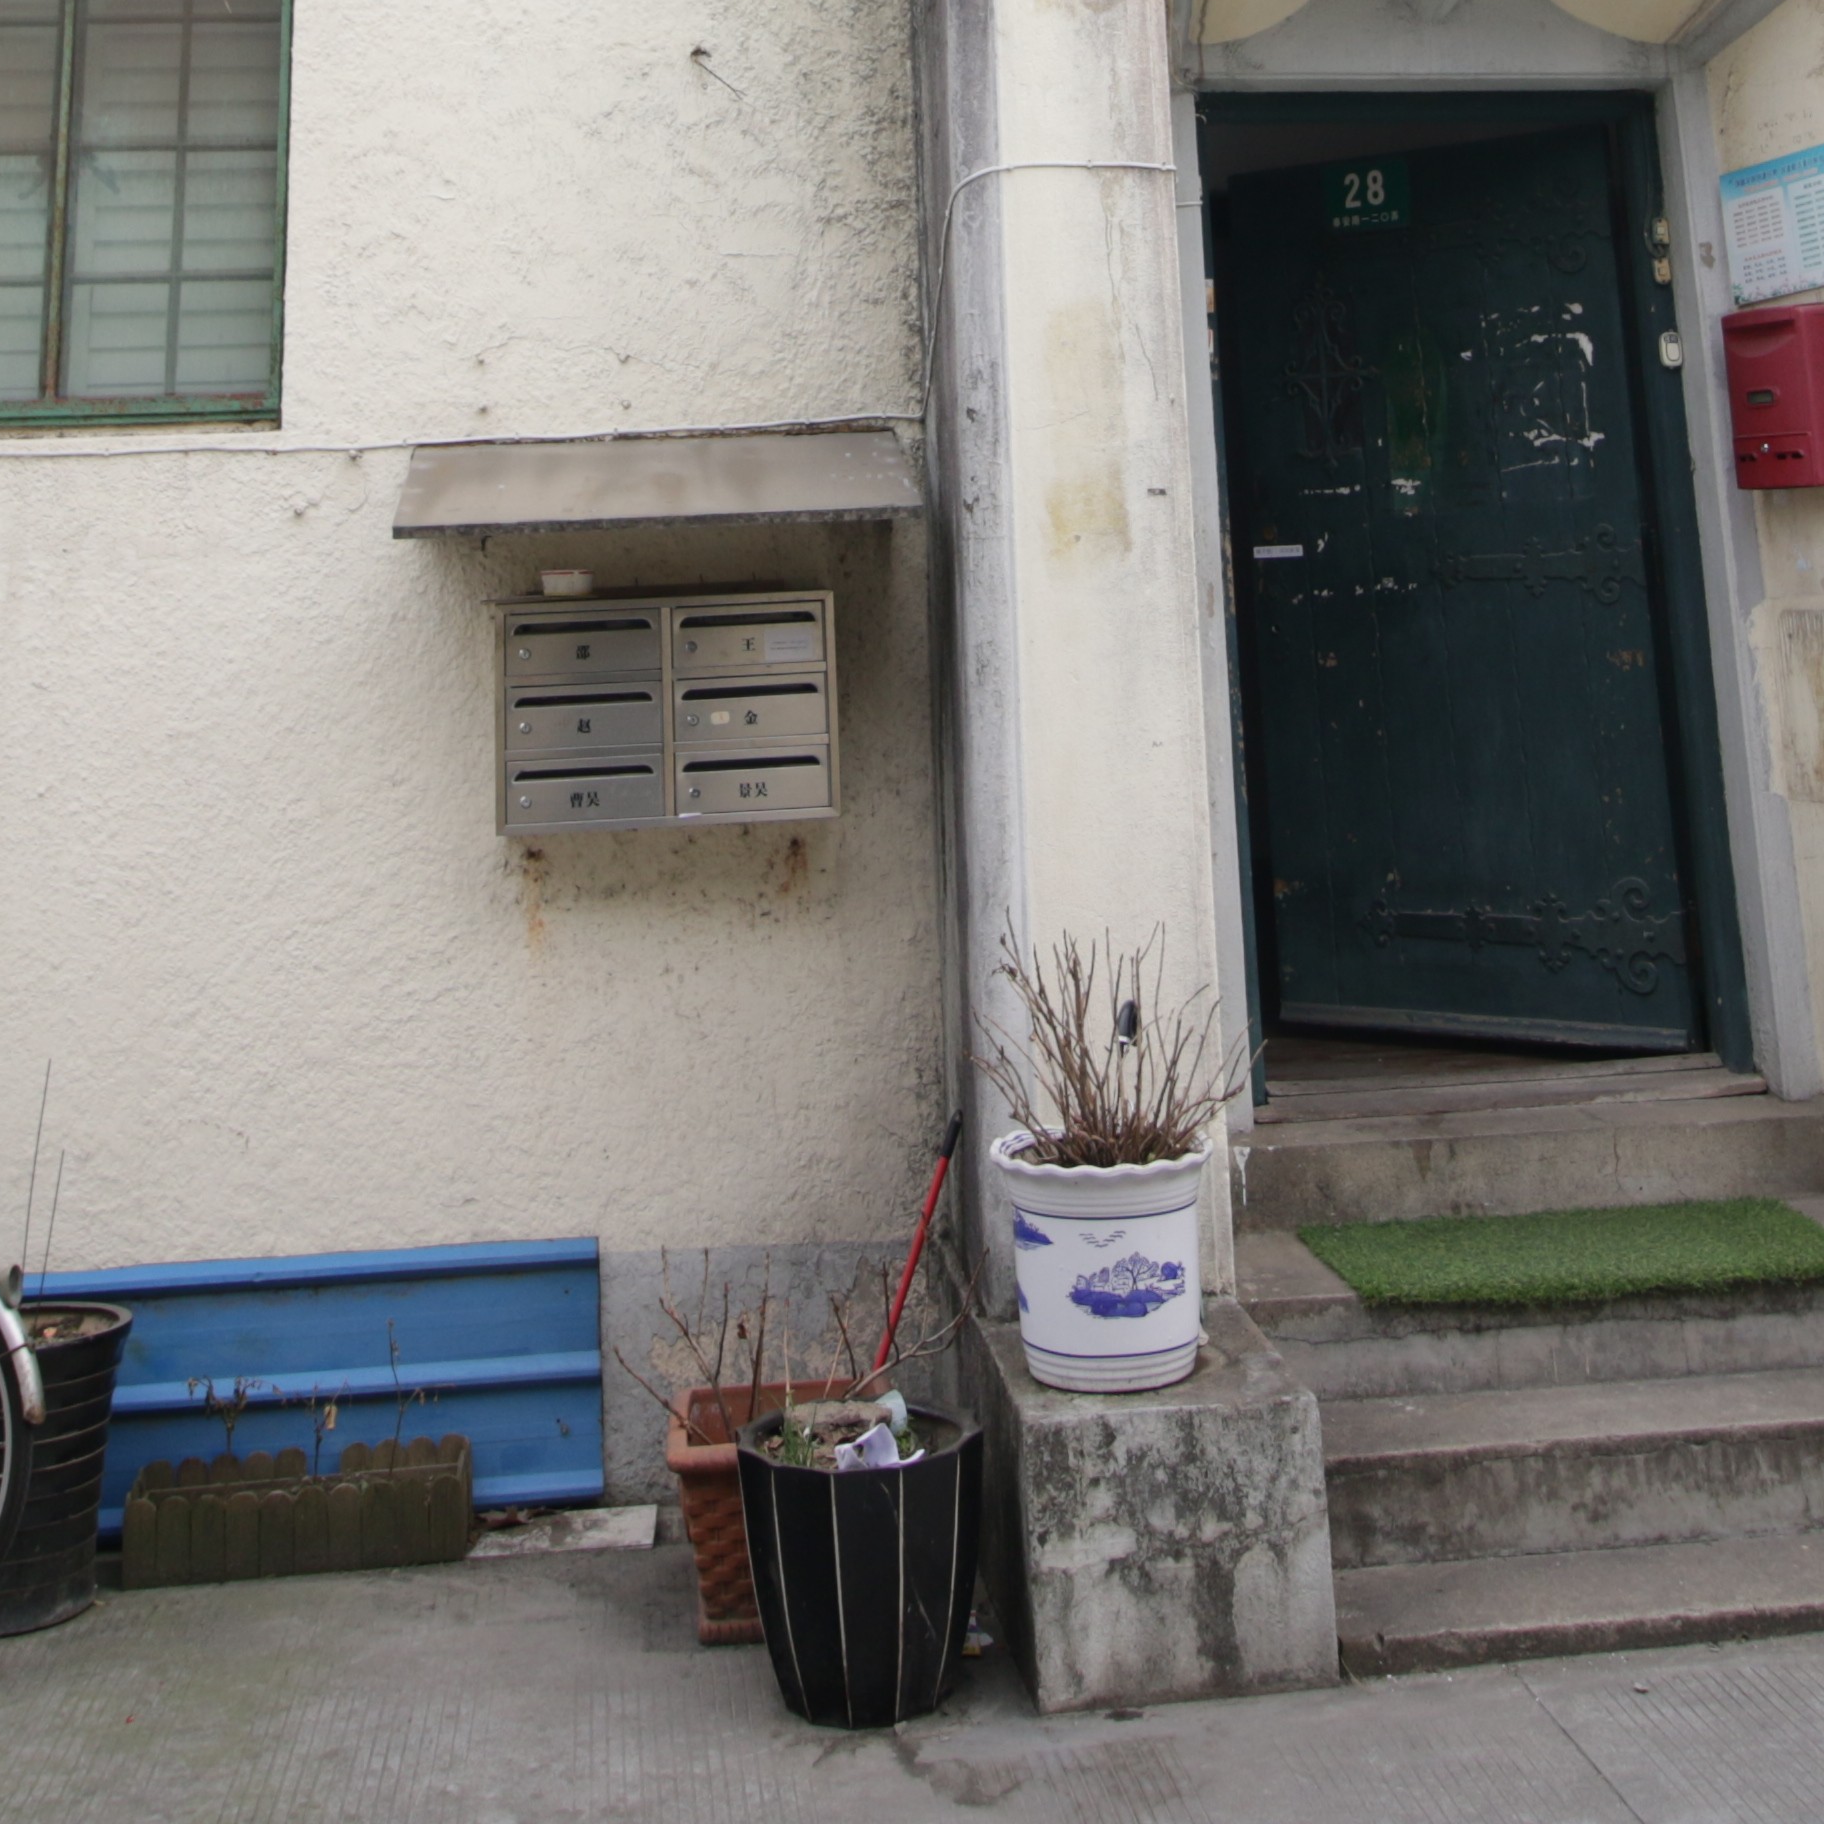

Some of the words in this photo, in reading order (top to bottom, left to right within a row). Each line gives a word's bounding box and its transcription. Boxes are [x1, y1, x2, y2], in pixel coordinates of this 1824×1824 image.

[1343, 169, 1385, 208] 28
[741, 637, 756, 652] 王
[744, 710, 758, 725] 金
